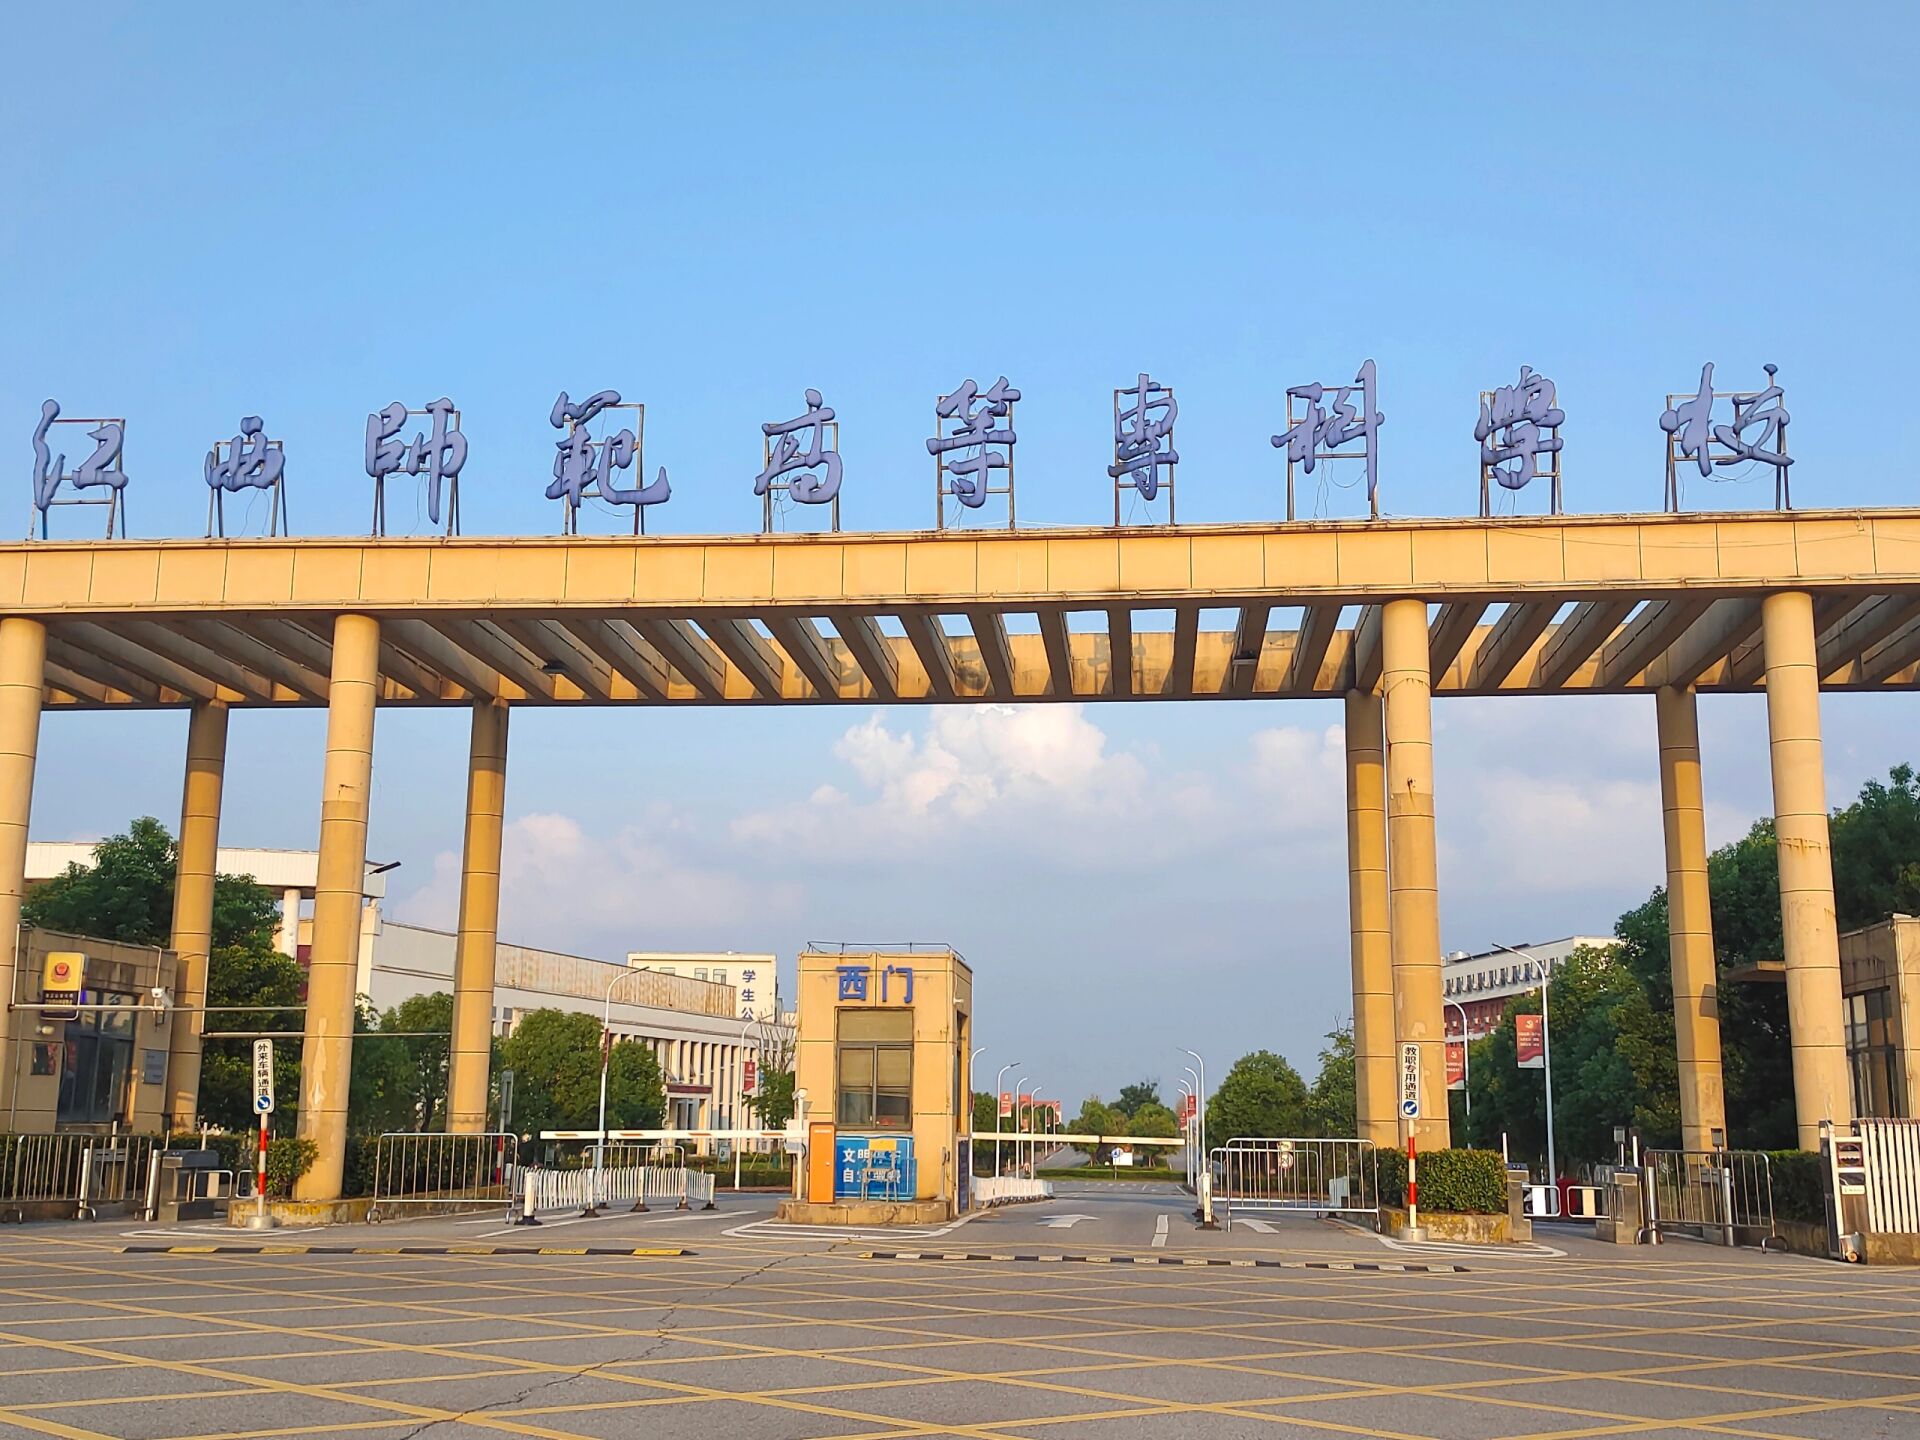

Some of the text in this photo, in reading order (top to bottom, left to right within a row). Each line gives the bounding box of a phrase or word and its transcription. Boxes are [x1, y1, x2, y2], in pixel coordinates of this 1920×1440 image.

[836, 965, 914, 1003] 西门
[257, 1043, 270, 1096] 外来车辆通道
[1404, 1046, 1417, 1100] 教职专用通道
